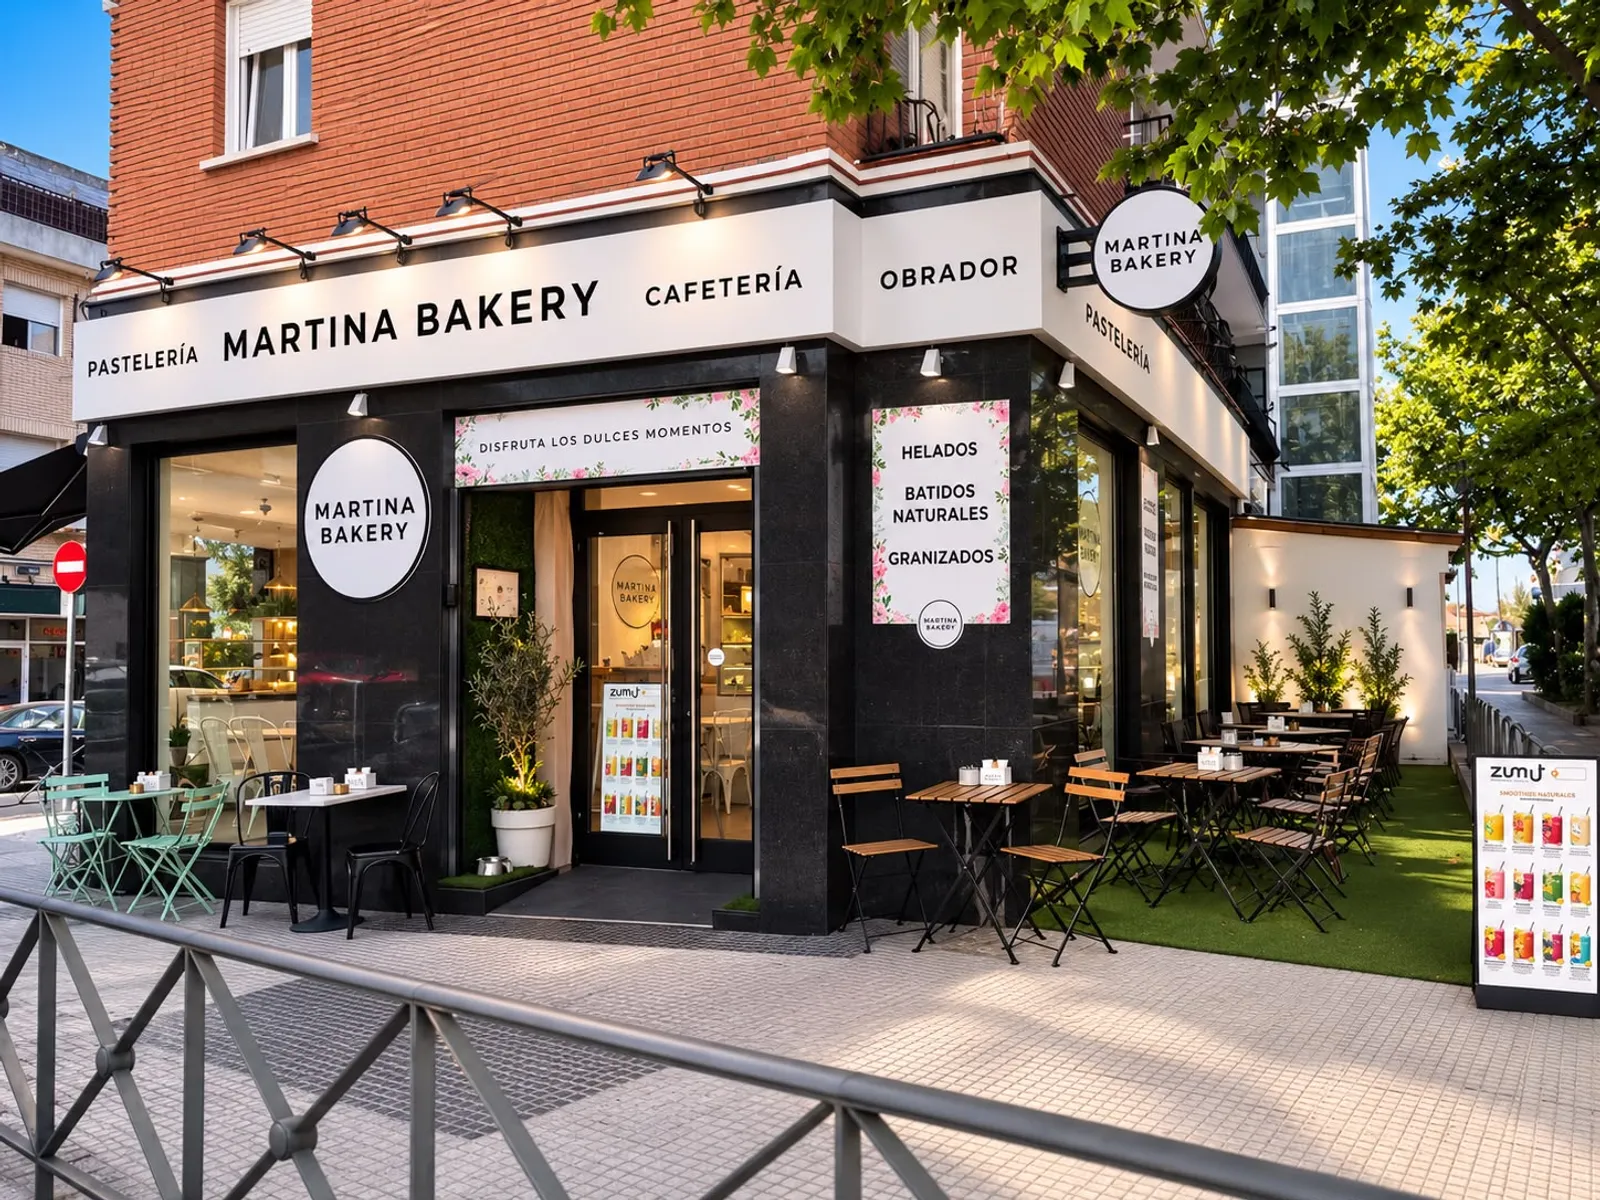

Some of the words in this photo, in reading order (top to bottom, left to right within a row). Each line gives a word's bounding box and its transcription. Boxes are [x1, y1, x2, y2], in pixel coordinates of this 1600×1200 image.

[1105, 229, 1203, 254] MARTINA
[881, 255, 1018, 290] OBRADOR
[1110, 249, 1196, 273] BAKERY
[646, 266, 803, 307] CAFETERÍA
[224, 308, 398, 362] MARTINA
[418, 281, 599, 337] BAKERY
[1086, 303, 1150, 374] PASTELERÍA
[89, 343, 198, 378] PASTELERÍA
[480, 438, 546, 454] DISFRUTA
[552, 435, 577, 447] LOS
[583, 430, 639, 445] DULCES
[646, 421, 732, 439] MOMENTOS
[902, 441, 978, 459] HELADOS
[905, 483, 975, 501] BATIDOS
[315, 496, 415, 520] MARTINA
[893, 506, 989, 524] NATURALES
[321, 521, 408, 545] BAKERY
[889, 549, 993, 566] GRANIZADOS
[617, 581, 657, 593] MARTINA
[619, 593, 655, 604] BAKERY
